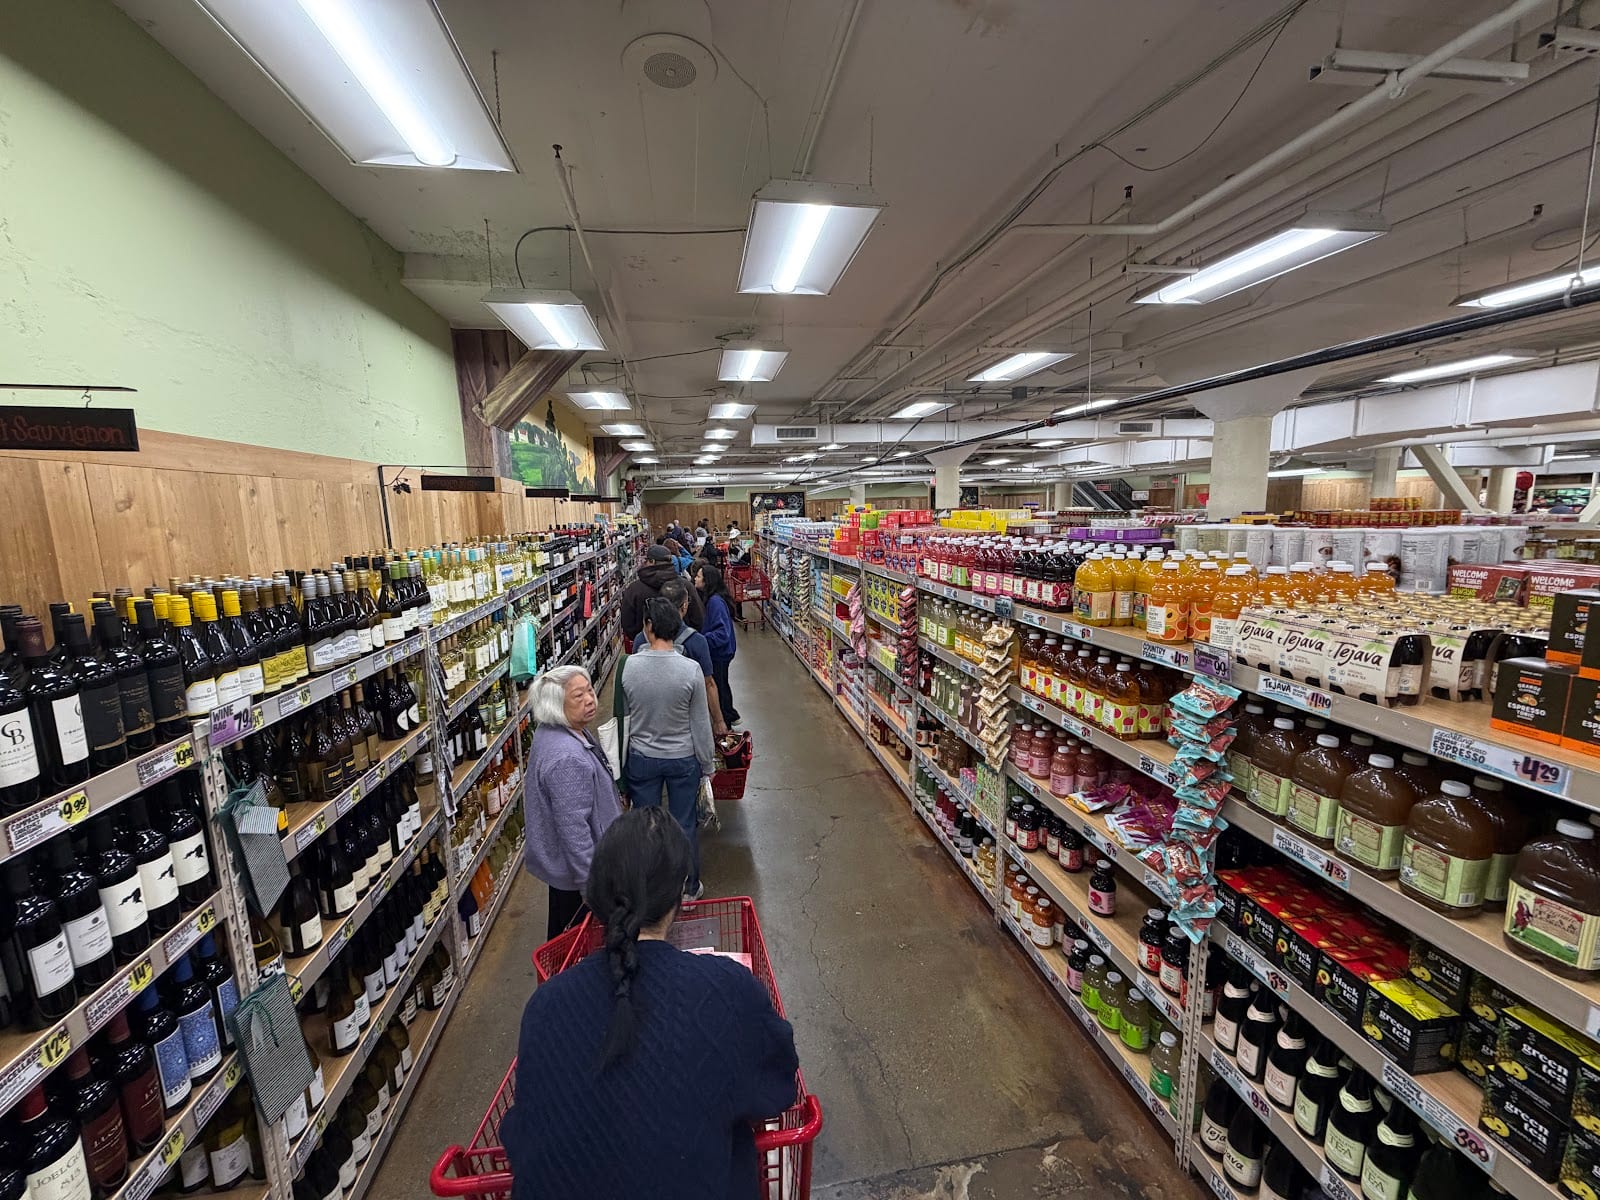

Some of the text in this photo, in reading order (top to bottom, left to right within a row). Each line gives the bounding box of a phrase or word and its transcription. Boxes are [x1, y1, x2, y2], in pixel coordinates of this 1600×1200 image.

[11, 415, 126, 446] Sauvignon
[1238, 619, 1274, 641] Tejava
[1282, 629, 1325, 653] Tejava
[1142, 642, 1166, 656] COUNTRY
[1333, 640, 1383, 667] Tejava
[1263, 678, 1291, 693] TEJAVA
[212, 704, 234, 723] WINE
[1507, 702, 1547, 716] ESPRESSO
[212, 721, 227, 734] BAG
[1432, 740, 1486, 764] ESPRESSO
[1432, 748, 1457, 761] TONIC
[1254, 914, 1274, 934] black
[1261, 927, 1274, 940] tea
[1289, 941, 1312, 964] black
[1298, 956, 1312, 970] tea
[1427, 950, 1462, 975] green
[1441, 966, 1461, 983] tea
[1332, 973, 1359, 999] black
[1342, 990, 1358, 1005] tea
[1378, 1009, 1411, 1037] green
[1391, 1027, 1411, 1045] tea
[1521, 1043, 1569, 1077] green
[1541, 1064, 1568, 1087] tea
[1503, 1101, 1550, 1137] green
[1523, 1121, 1548, 1146] tea
